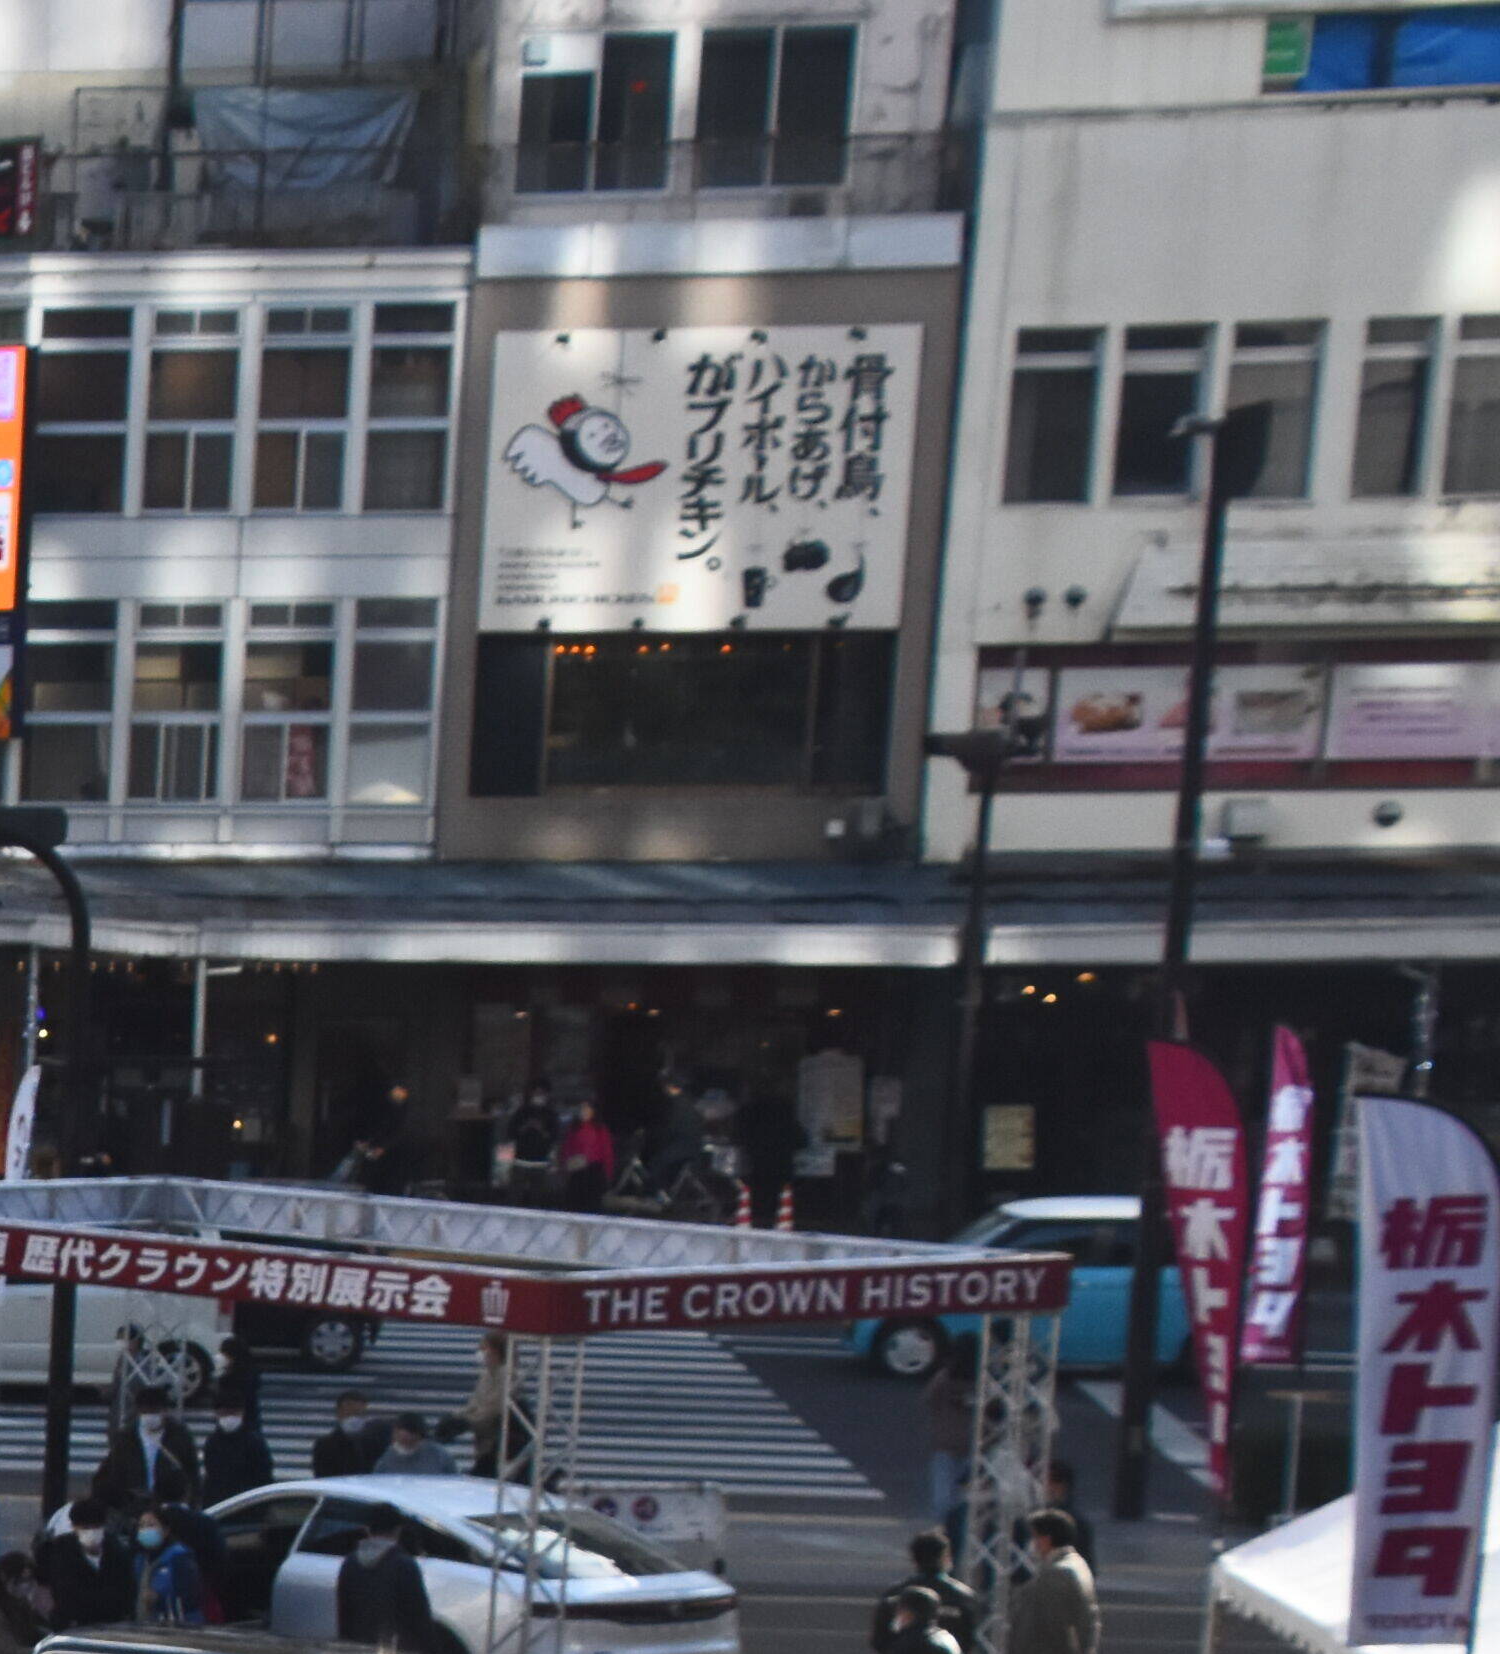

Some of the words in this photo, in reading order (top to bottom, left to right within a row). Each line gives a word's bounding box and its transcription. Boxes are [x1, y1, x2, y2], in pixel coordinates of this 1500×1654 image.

[741, 352, 789, 514] ハイボール、
[789, 354, 837, 510] からあげ、
[835, 353, 894, 517] 骨付鳥、
[21, 1235, 451, 1317] 歴代クラウン特別展示会
[584, 1287, 669, 1323] THE
[683, 1278, 847, 1318] CROWN
[862, 1267, 1047, 1310] HISTORY
[1373, 1194, 1489, 1598] 栃木トヨタ
